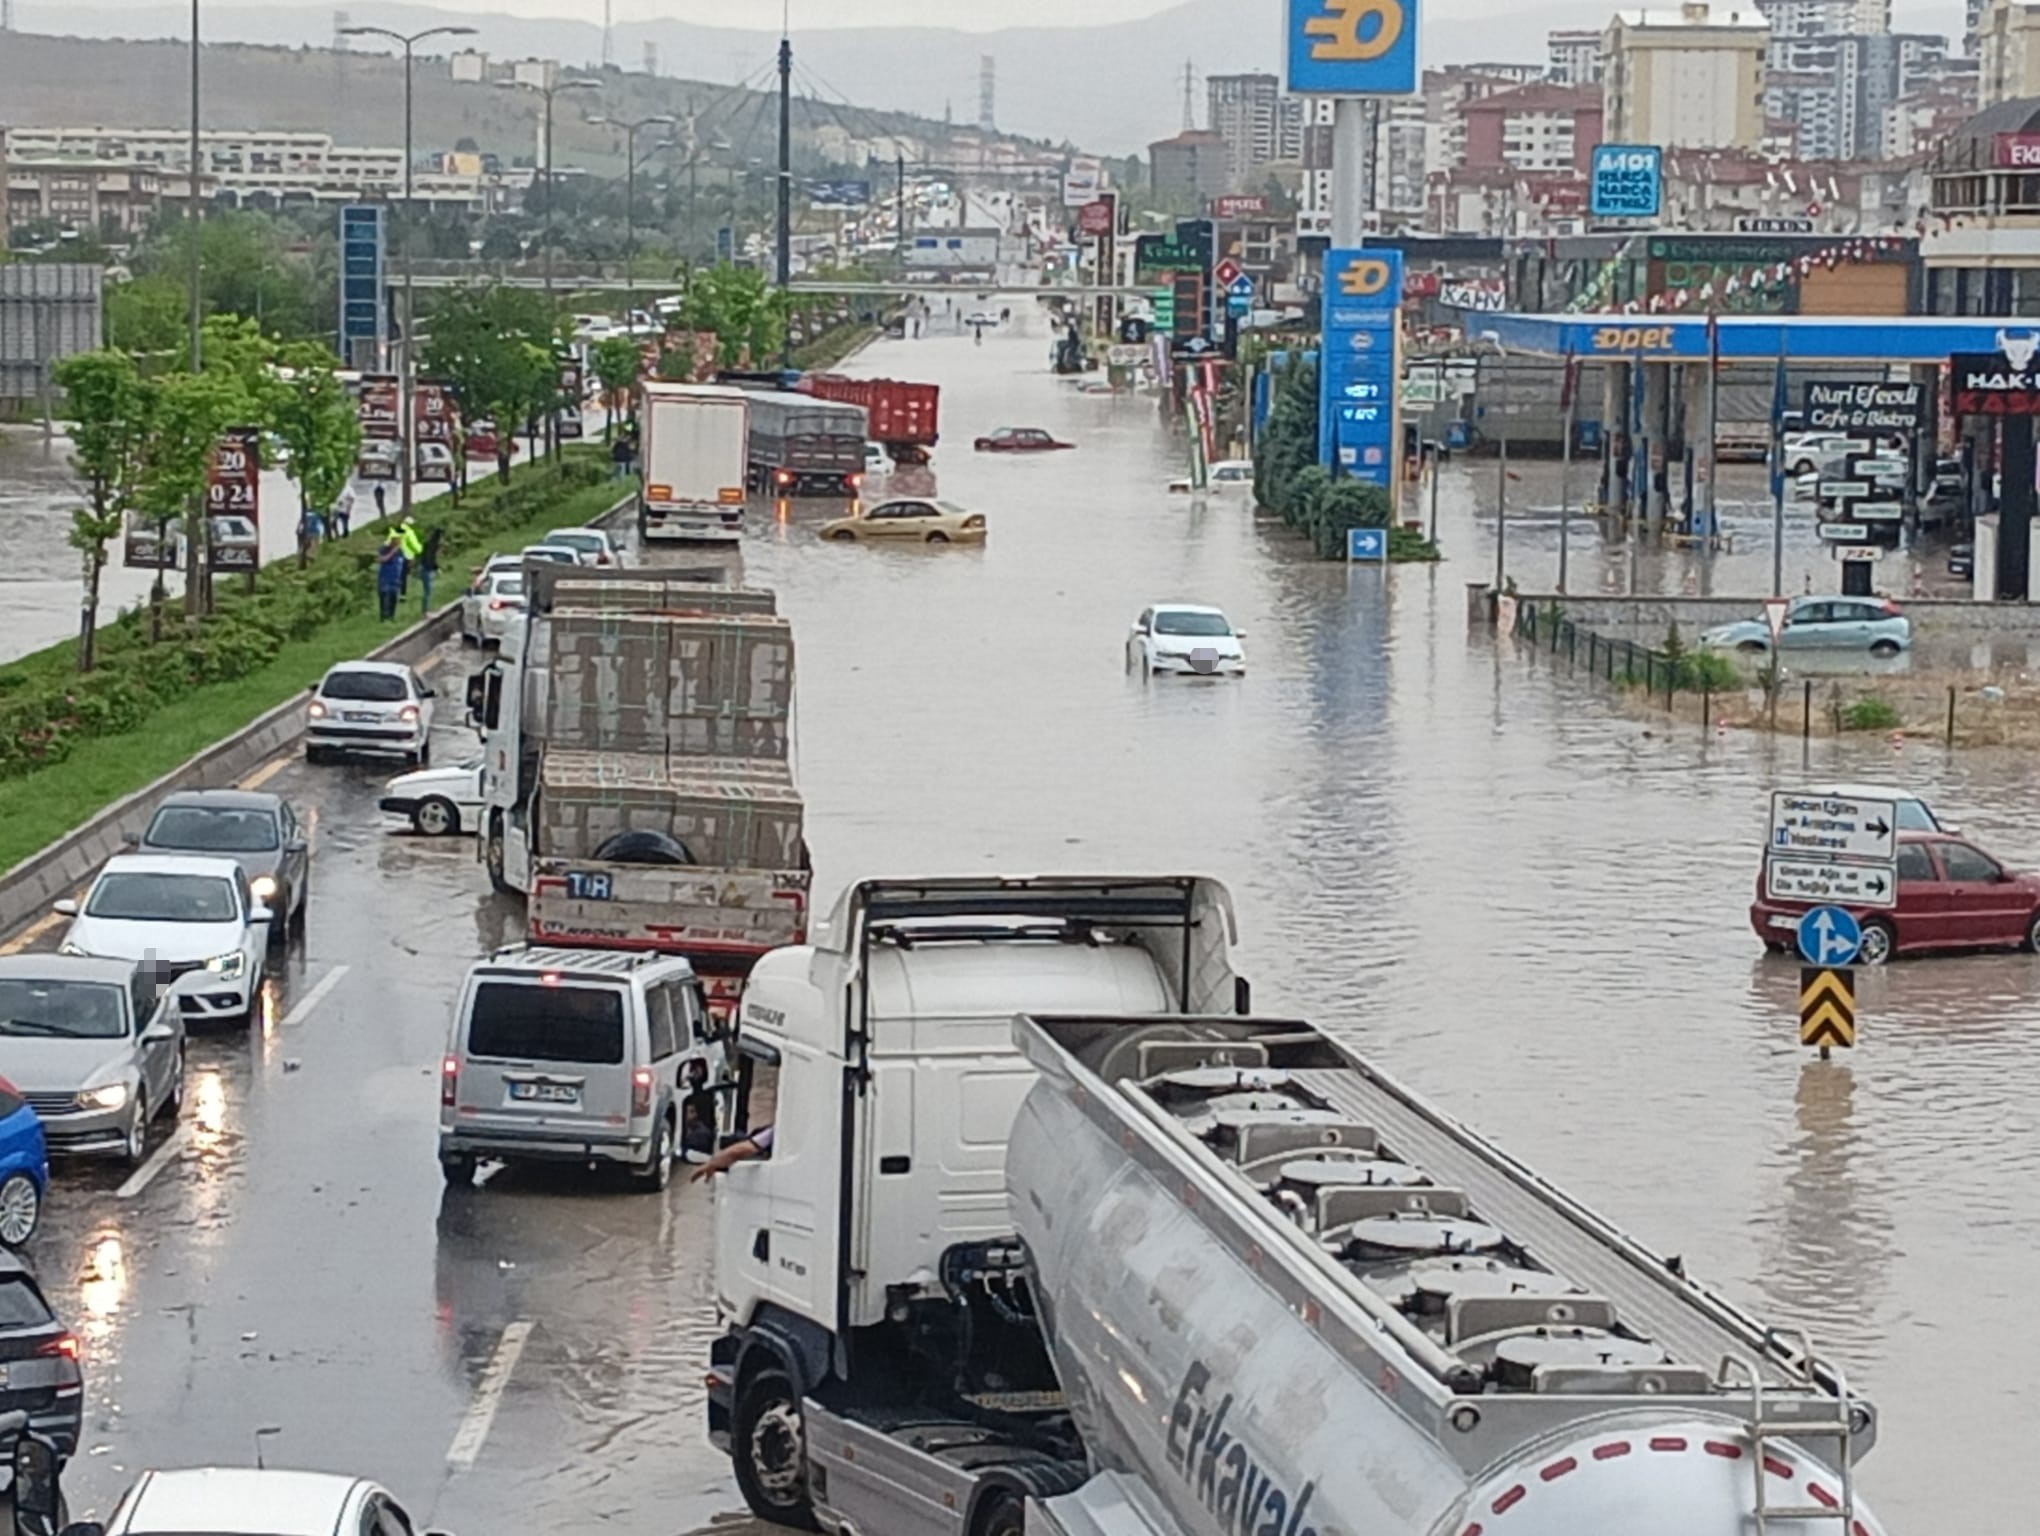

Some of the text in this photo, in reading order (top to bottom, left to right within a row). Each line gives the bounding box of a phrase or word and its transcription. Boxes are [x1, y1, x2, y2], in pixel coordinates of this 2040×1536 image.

[1599, 153, 1654, 171] A101
[1592, 326, 1674, 351] opet
[1810, 385, 1853, 404] Nuri
[217, 450, 246, 470] 20
[569, 873, 609, 898] TIR
[1167, 1361, 1318, 1536] Erkaval
